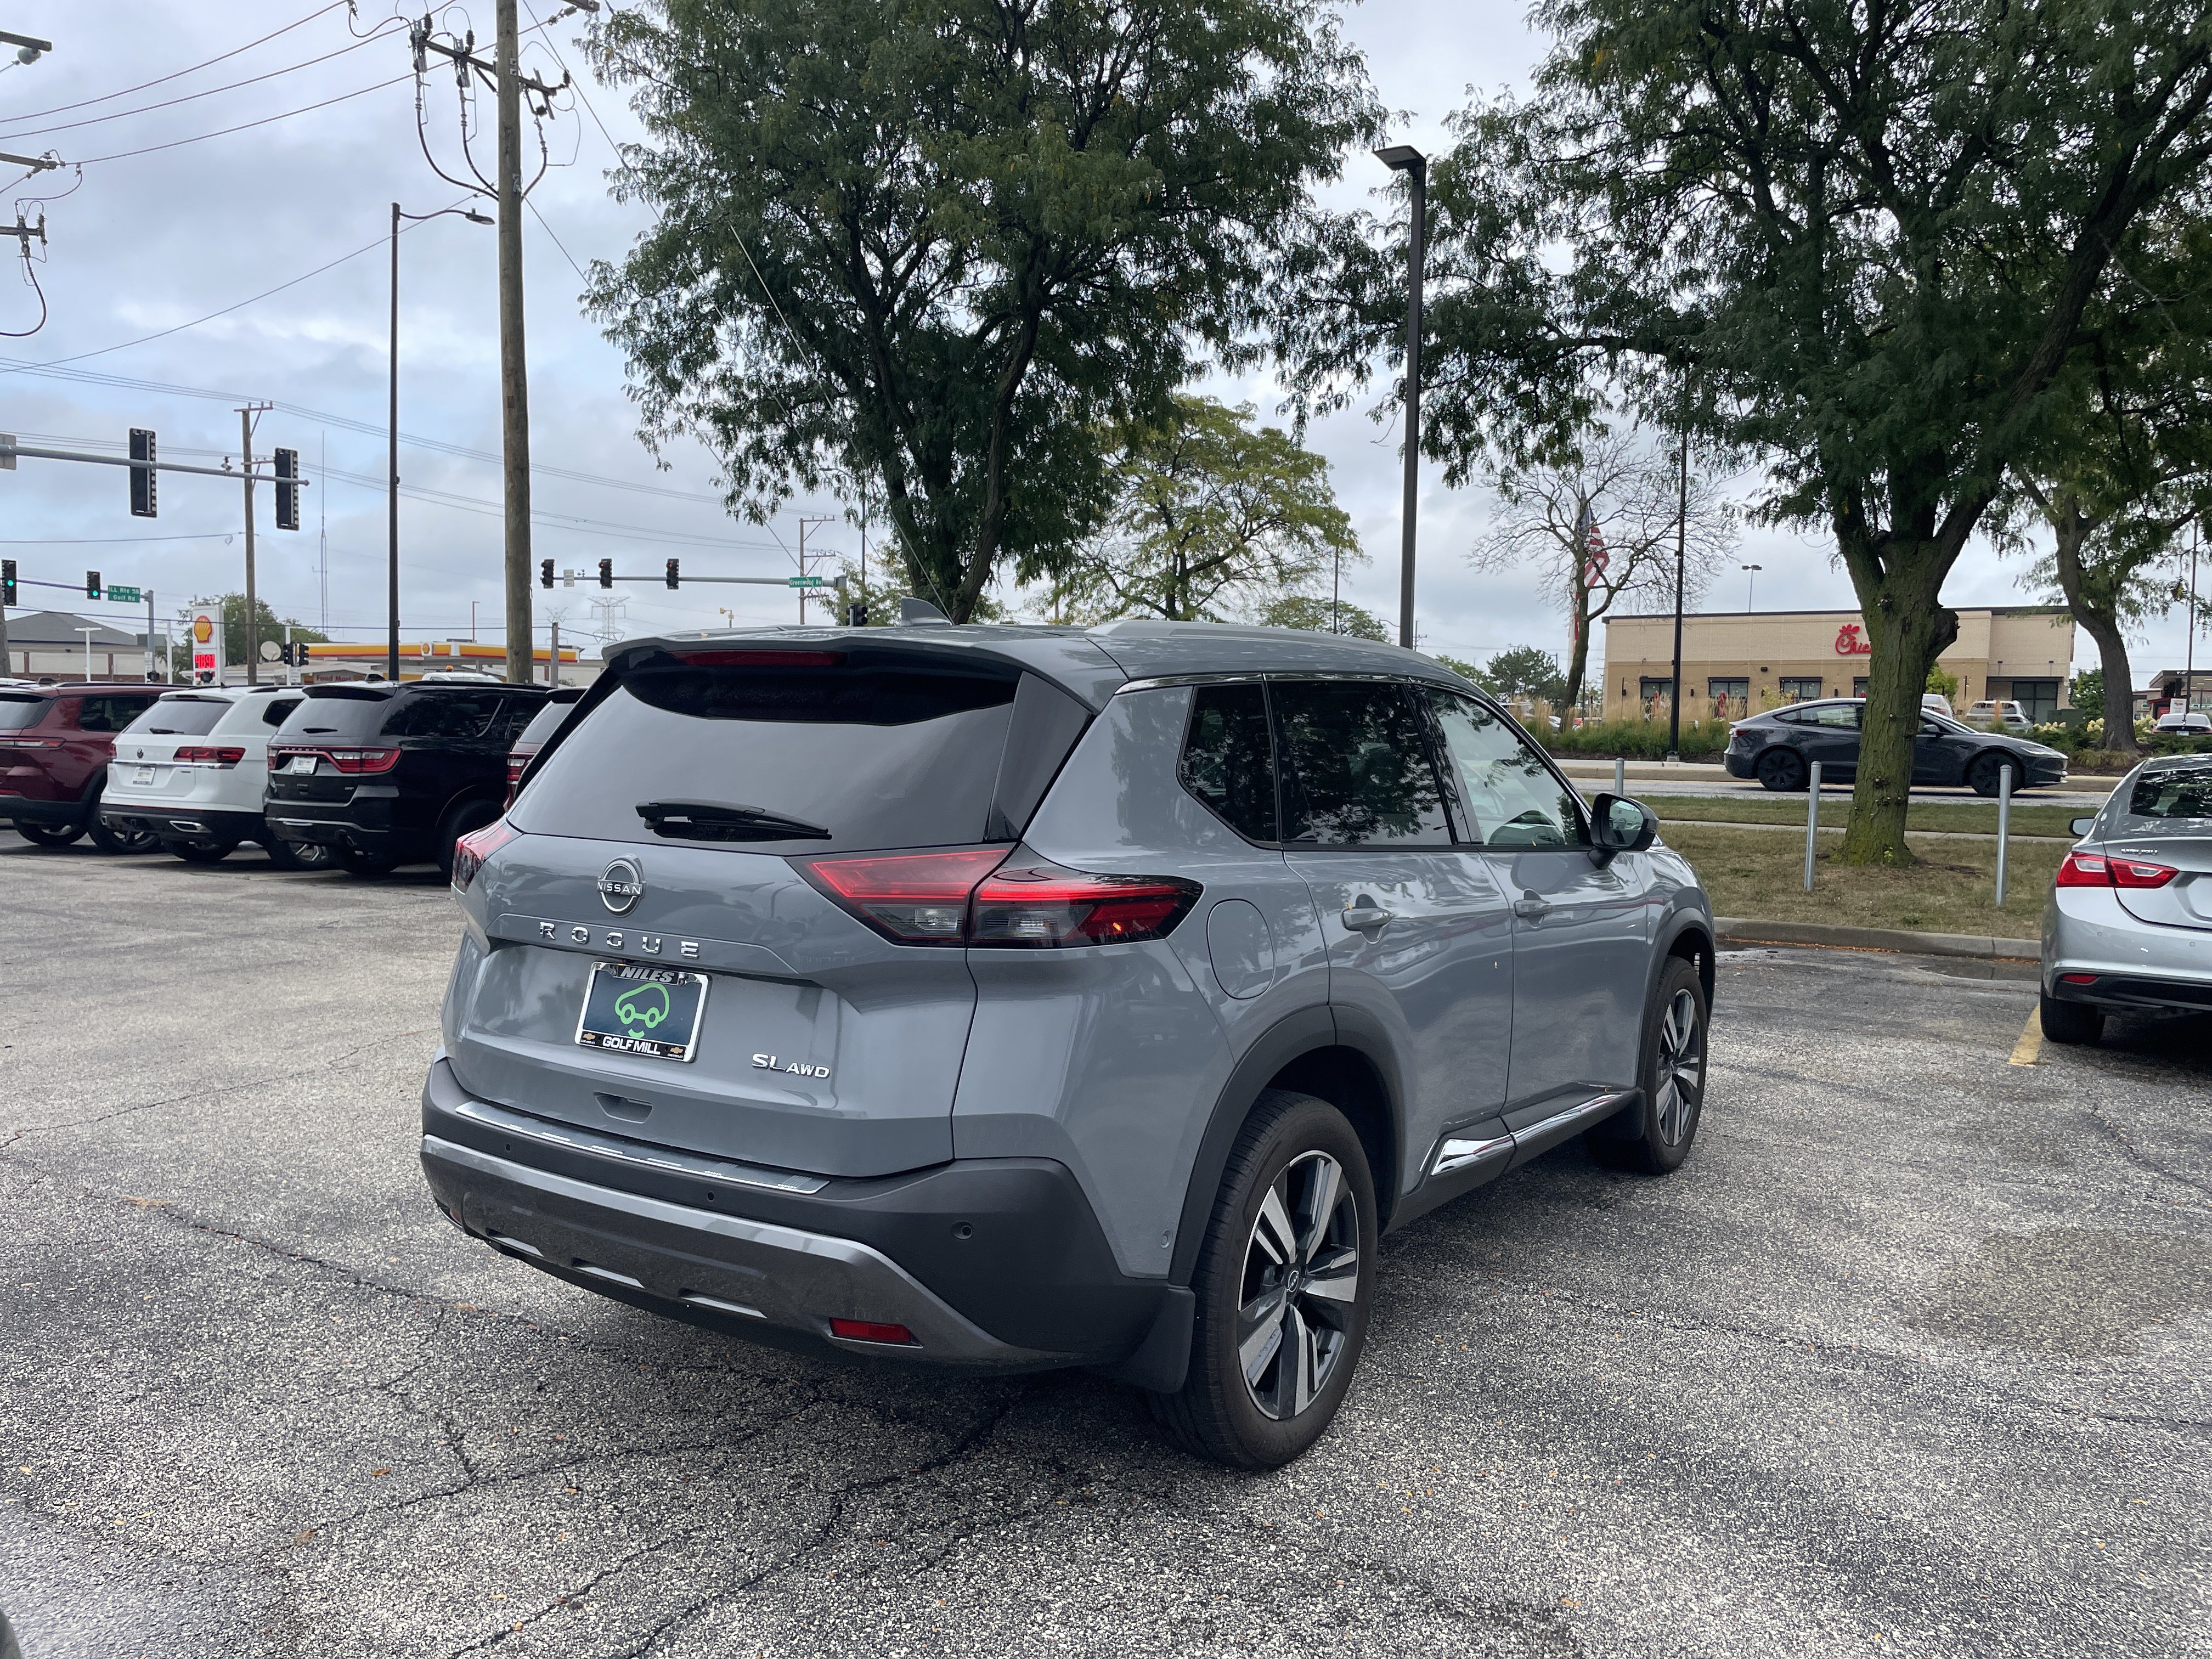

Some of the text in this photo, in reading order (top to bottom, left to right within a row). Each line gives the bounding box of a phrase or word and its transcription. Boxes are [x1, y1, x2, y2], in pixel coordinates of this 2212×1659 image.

[1835, 624, 1872, 654] Chic
[597, 881, 641, 895] NISSAN
[539, 922, 700, 959] ROGUE
[620, 967, 675, 983] NILES
[602, 1036, 661, 1054] GOLF MILL
[786, 1062, 831, 1078] AWD
